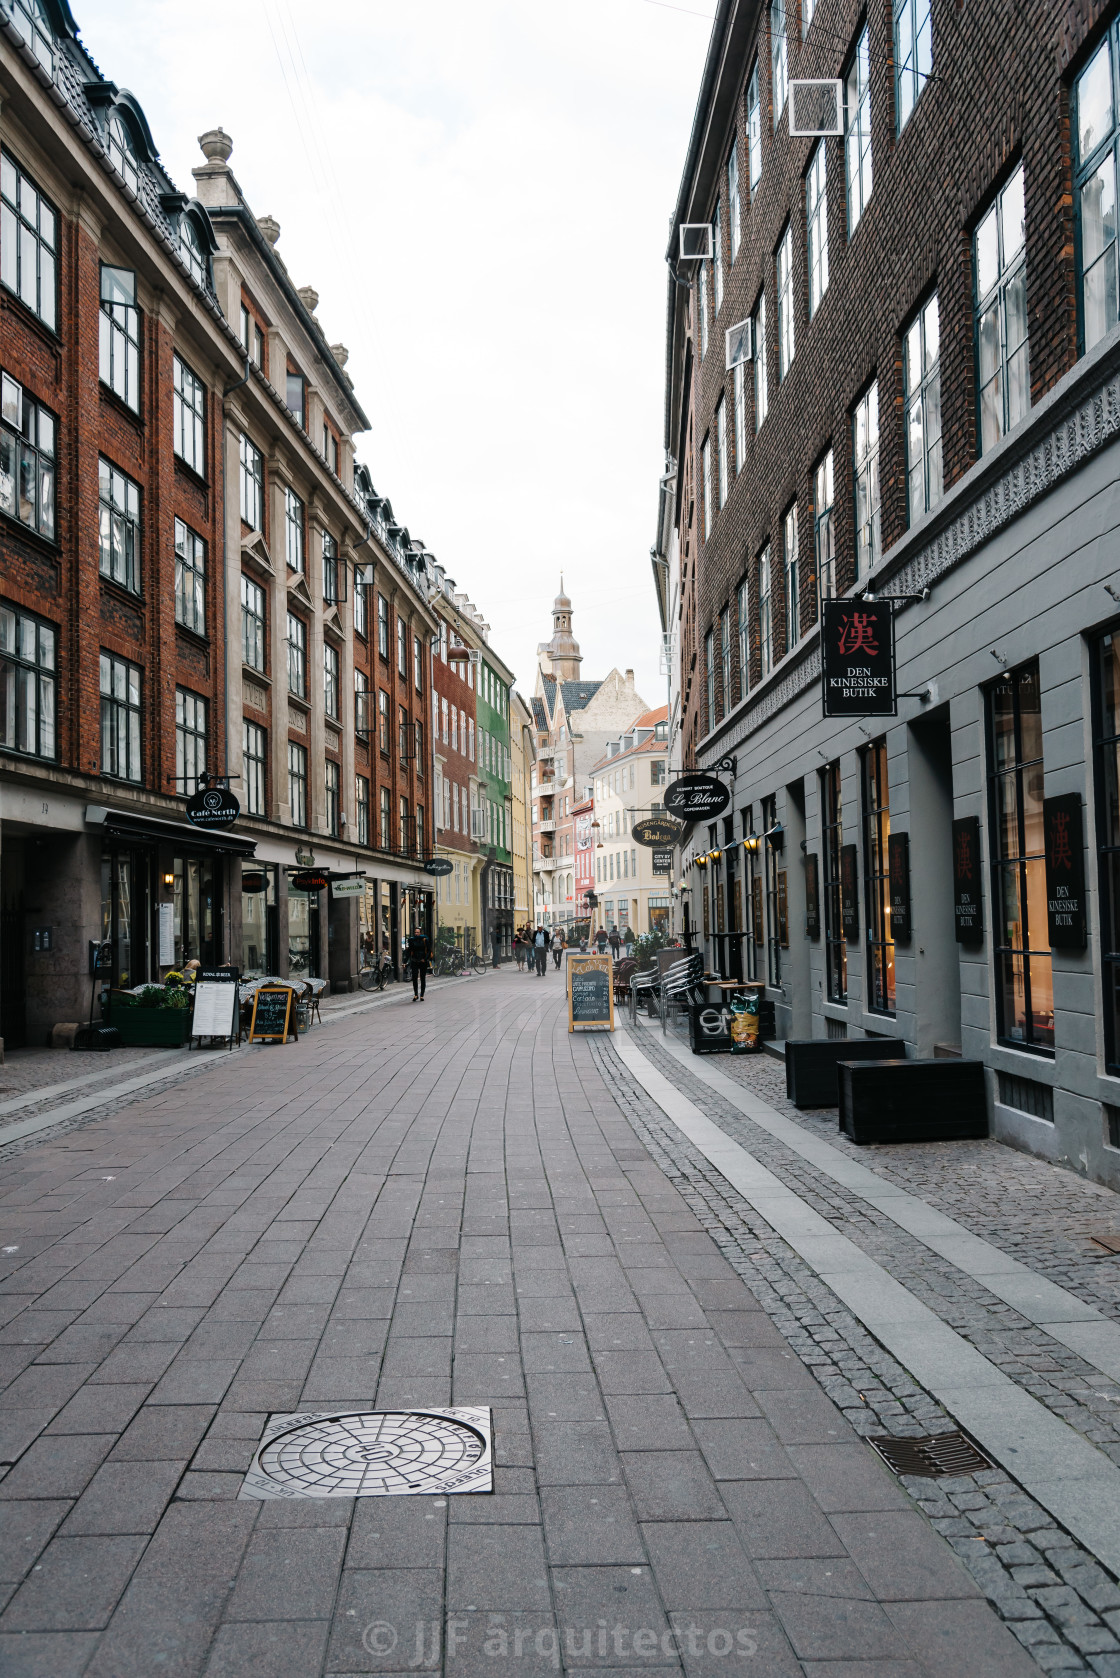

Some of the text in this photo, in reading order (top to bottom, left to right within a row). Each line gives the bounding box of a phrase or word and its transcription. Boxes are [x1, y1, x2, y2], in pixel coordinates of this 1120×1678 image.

[837, 612, 880, 656] 漢
[847, 667, 871, 677] DEN
[830, 677, 889, 687] KINESISKE
[843, 688, 877, 698] BUTIK
[668, 792, 725, 806] Le Blanc
[190, 808, 236, 817] Café North
[642, 829, 671, 842] Bodega
[1050, 811, 1072, 870] 漢
[1056, 886, 1069, 898] DEN
[1048, 899, 1079, 912] KINESISKE
[1055, 914, 1073, 926] BUTIK
[355, 1443, 394, 1461] 40
